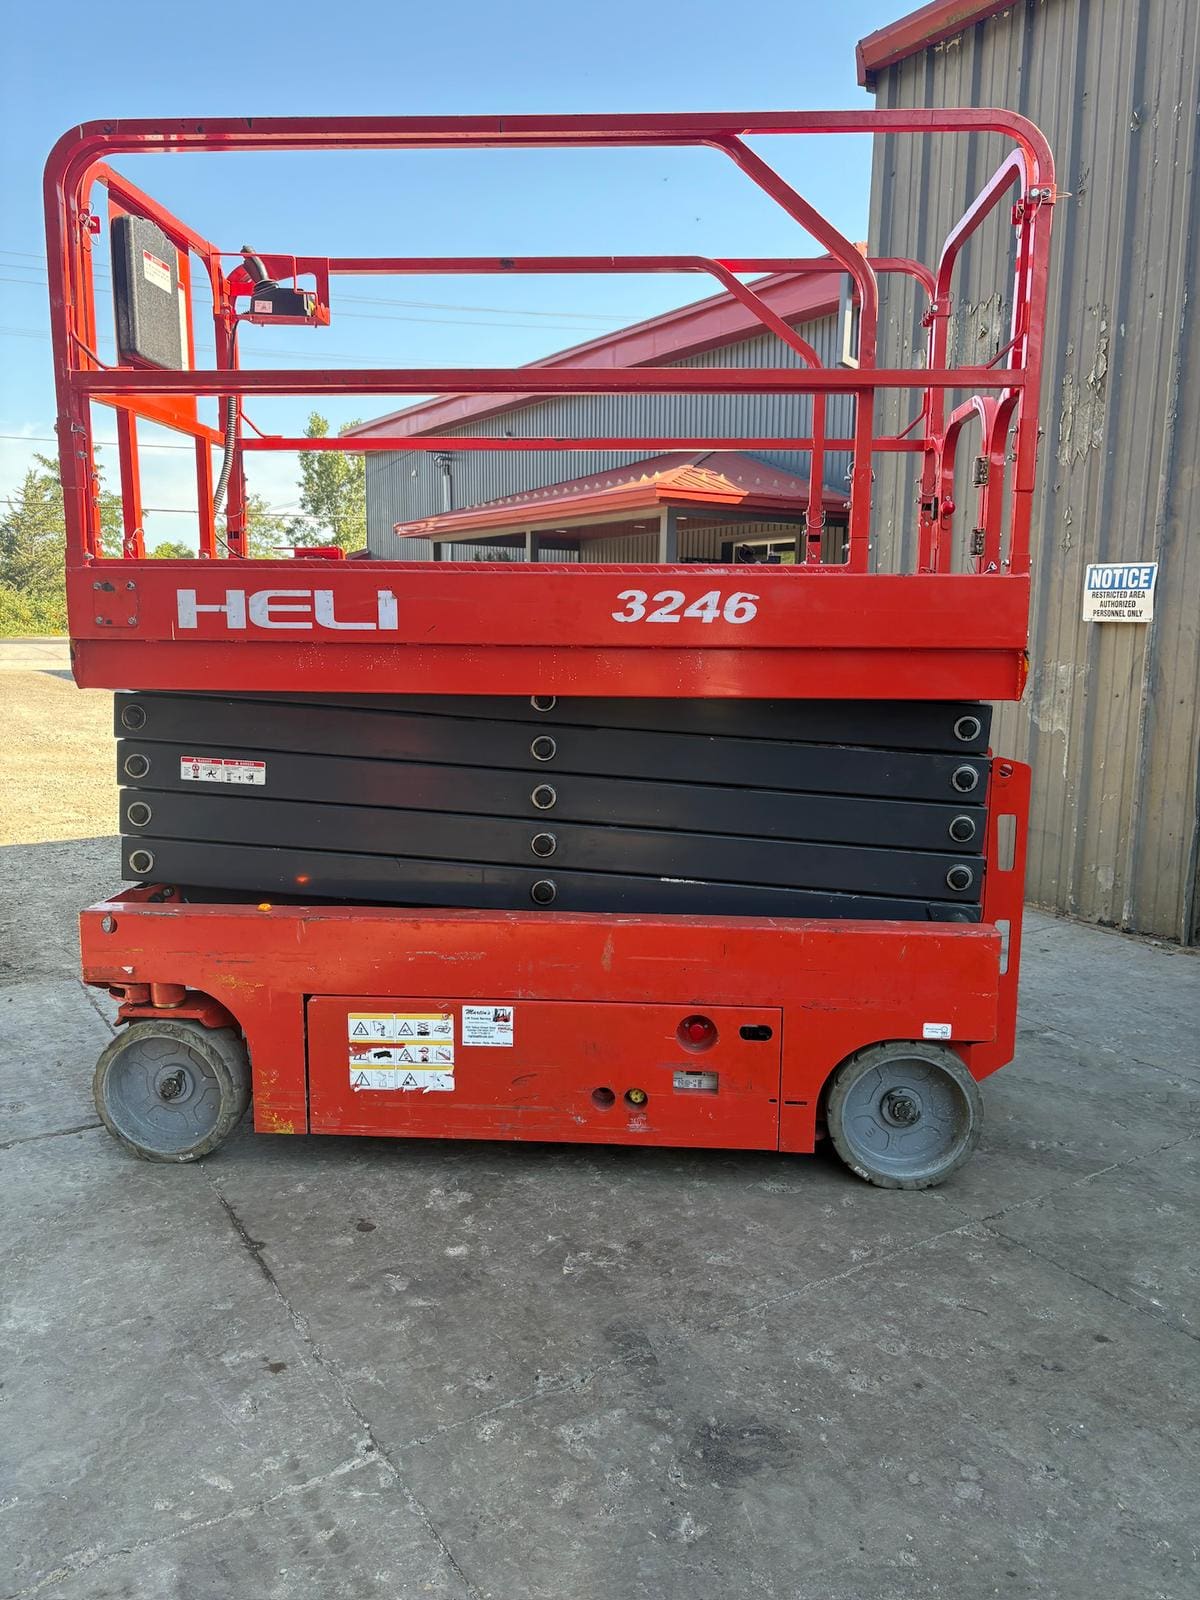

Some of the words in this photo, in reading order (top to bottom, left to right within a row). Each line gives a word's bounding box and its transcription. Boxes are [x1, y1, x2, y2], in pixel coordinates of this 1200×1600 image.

[1090, 568, 1151, 588] NOTICE
[176, 588, 399, 630] HELI
[611, 589, 761, 624] 3246
[1092, 609, 1126, 617] PERSONNEL
[1099, 600, 1136, 608] AUTHORIZED
